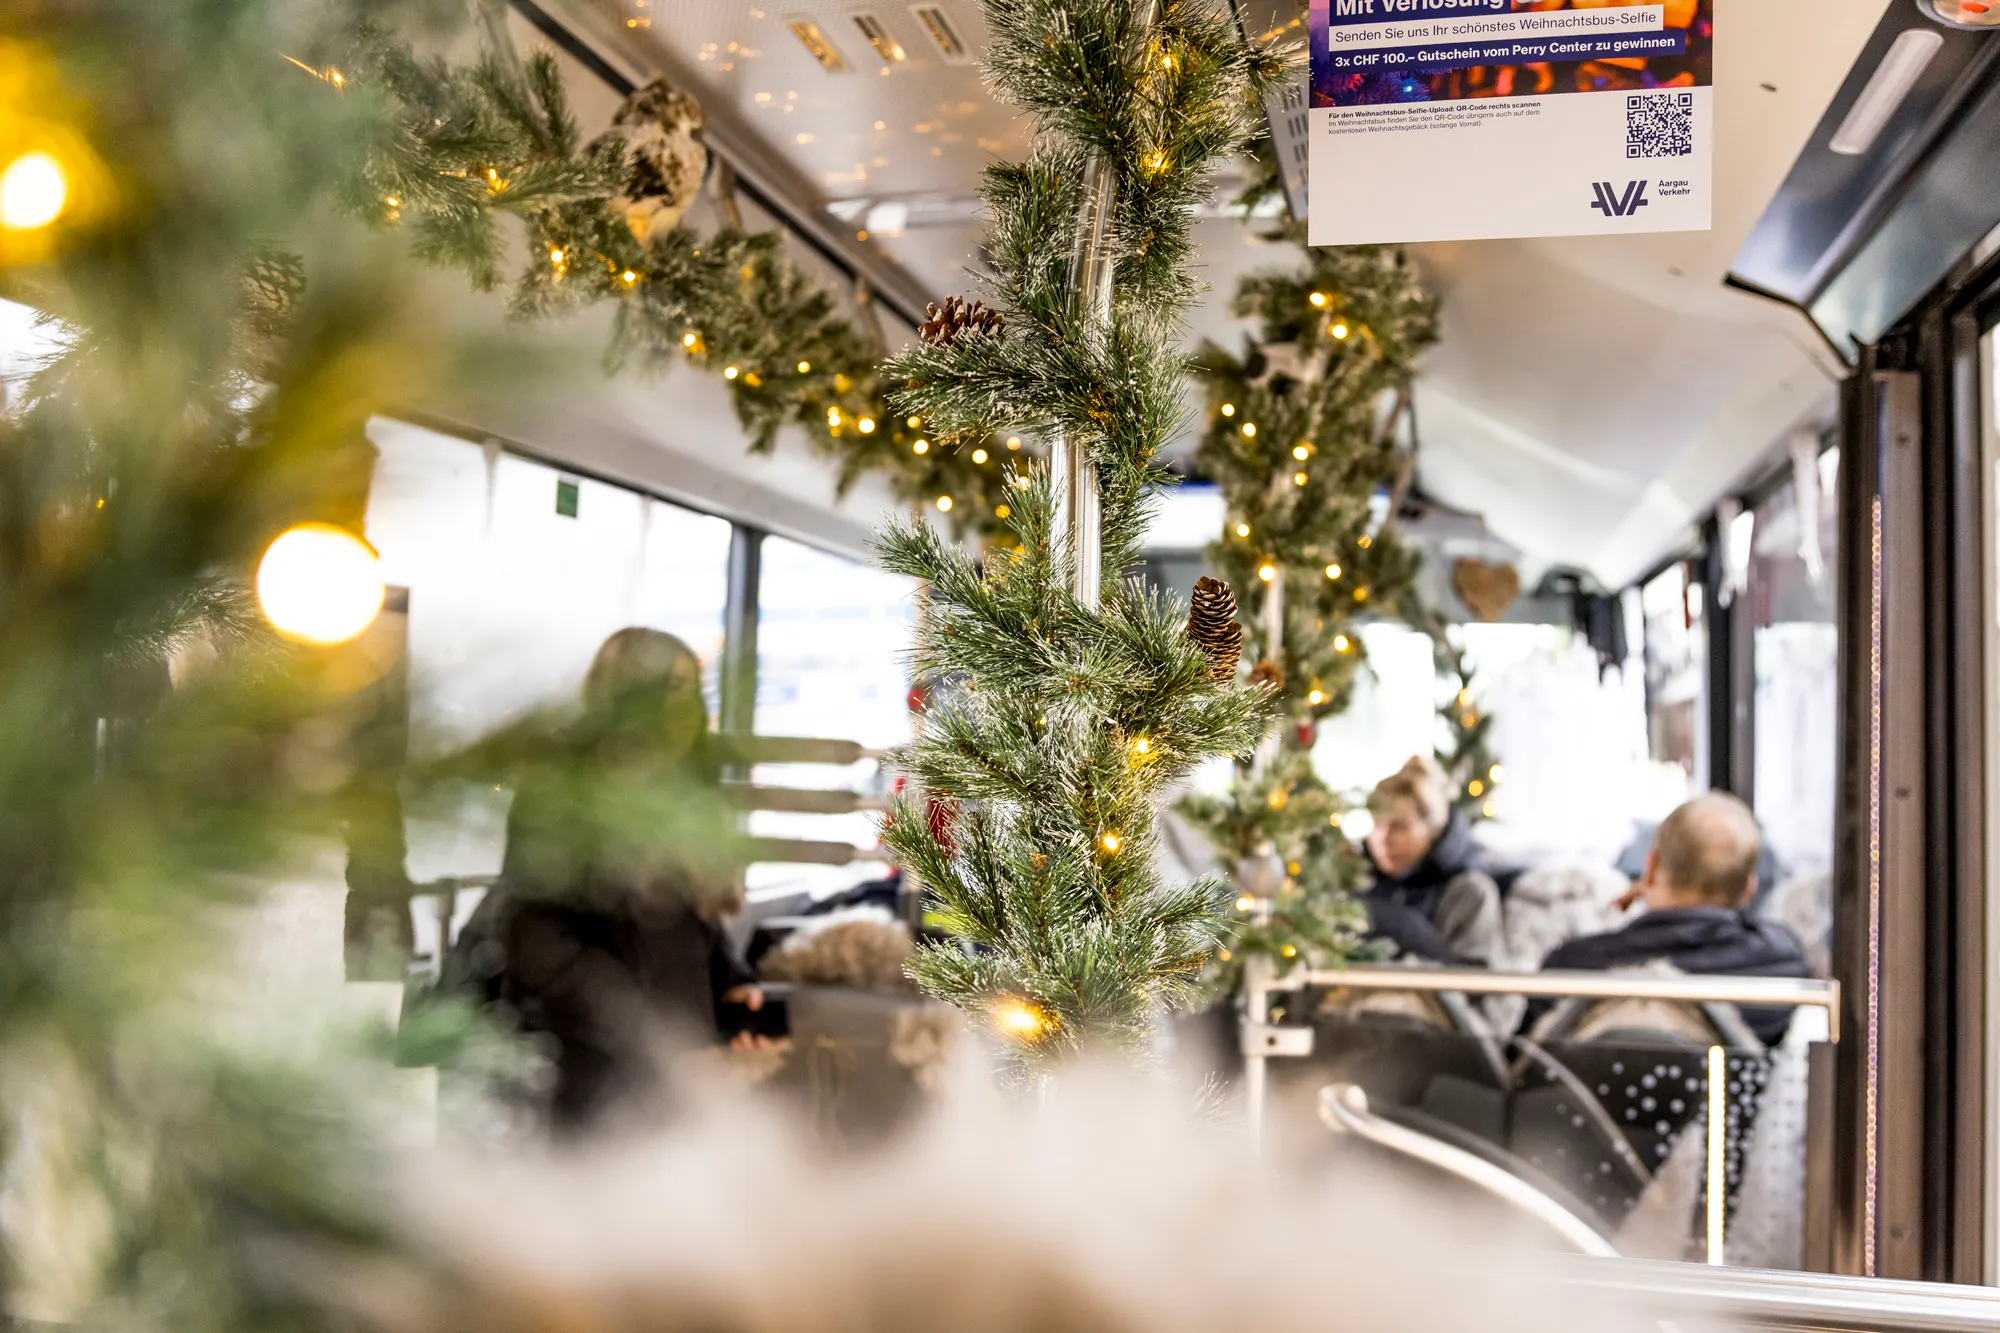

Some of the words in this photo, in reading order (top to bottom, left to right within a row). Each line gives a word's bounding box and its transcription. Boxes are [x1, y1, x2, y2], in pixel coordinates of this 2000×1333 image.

[1336, 0, 1374, 16] Mit
[1335, 30, 1381, 43] Senden
[1385, 28, 1404, 39] Sie
[1408, 27, 1429, 38] uns
[1433, 25, 1449, 36] Ihr
[1452, 20, 1516, 35] schönstes
[1520, 12, 1656, 30] Weihnachtsbus-Selfie
[1335, 57, 1350, 67] 3x
[1353, 54, 1379, 66] CHF
[1418, 47, 1480, 62] Gutschein
[1484, 48, 1509, 57] vom
[1512, 44, 1546, 57] Perry
[1550, 42, 1593, 54] Center
[1596, 41, 1611, 51] zu
[1614, 37, 1675, 52] gewinnen
[1355, 107, 1455, 117] Weihnachtsbus-Selfie-Upload:
[1368, 124, 1428, 132] Weihnachtsgebäck
